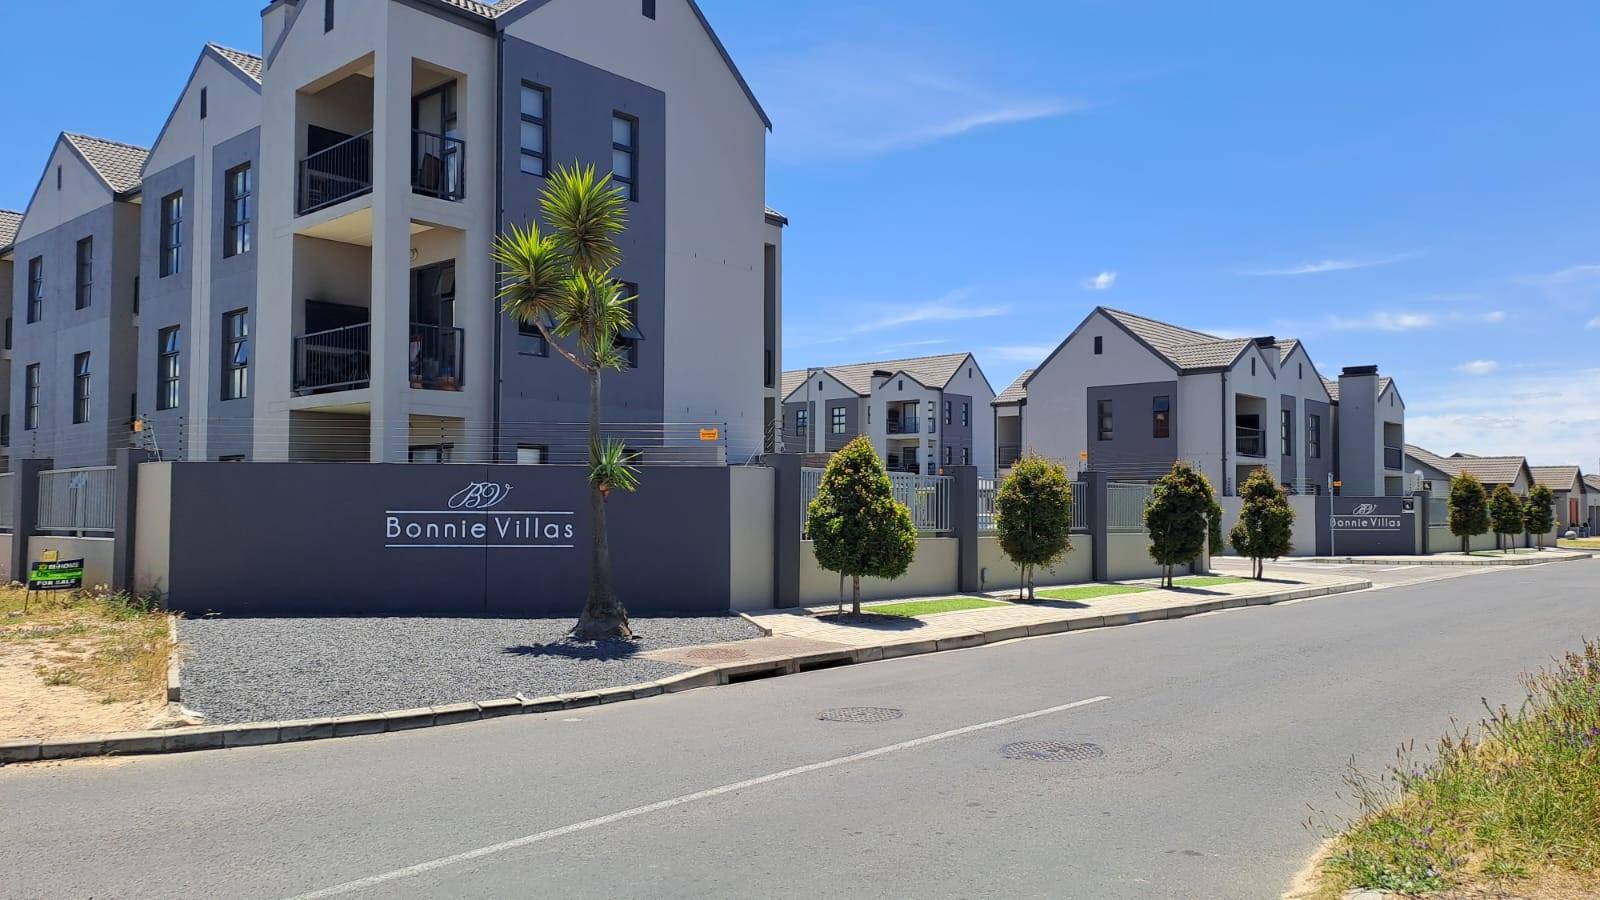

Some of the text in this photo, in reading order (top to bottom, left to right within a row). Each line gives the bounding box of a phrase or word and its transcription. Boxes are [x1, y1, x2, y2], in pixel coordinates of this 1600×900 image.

[386, 516, 574, 539] Bonnie Villas
[1370, 517, 1401, 528] Villas
